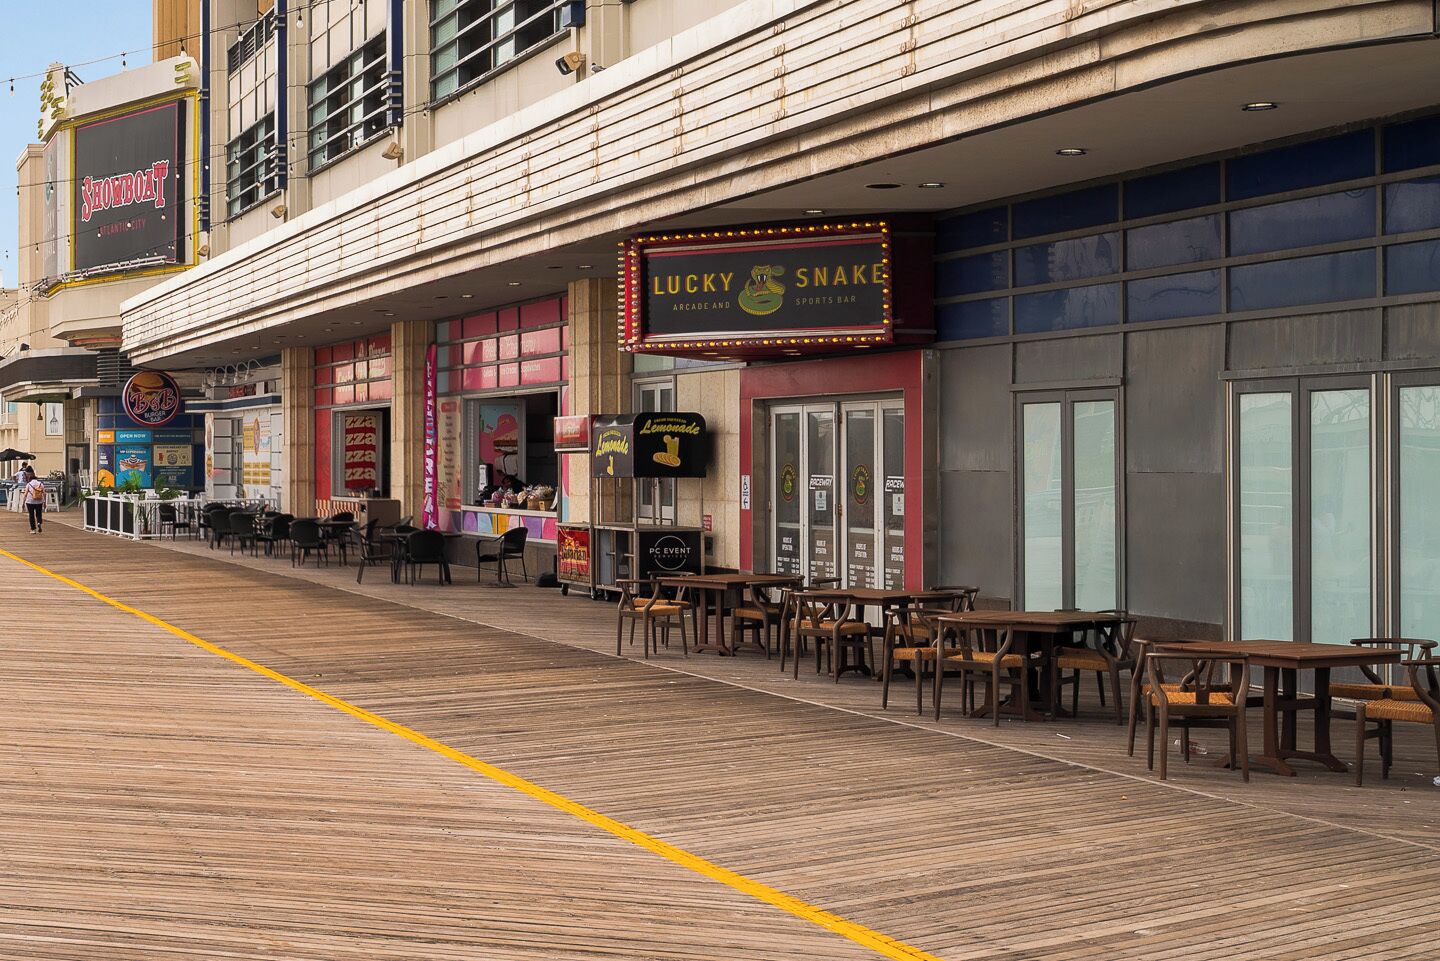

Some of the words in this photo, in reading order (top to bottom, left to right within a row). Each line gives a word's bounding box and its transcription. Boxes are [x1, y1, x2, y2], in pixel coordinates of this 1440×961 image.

[81, 160, 169, 222] SHOWBOAT
[653, 272, 734, 295] LUCKY
[796, 263, 885, 288] SNAKE
[673, 302, 709, 311] ARCADE
[712, 301, 730, 309] AND
[795, 296, 833, 306] SPORTS
[837, 295, 856, 304] BAR
[144, 410, 166, 419] BURGER
[640, 420, 700, 435] Lemonade
[595, 434, 629, 457] Lemonade
[810, 478, 833, 487] RACEWAY
